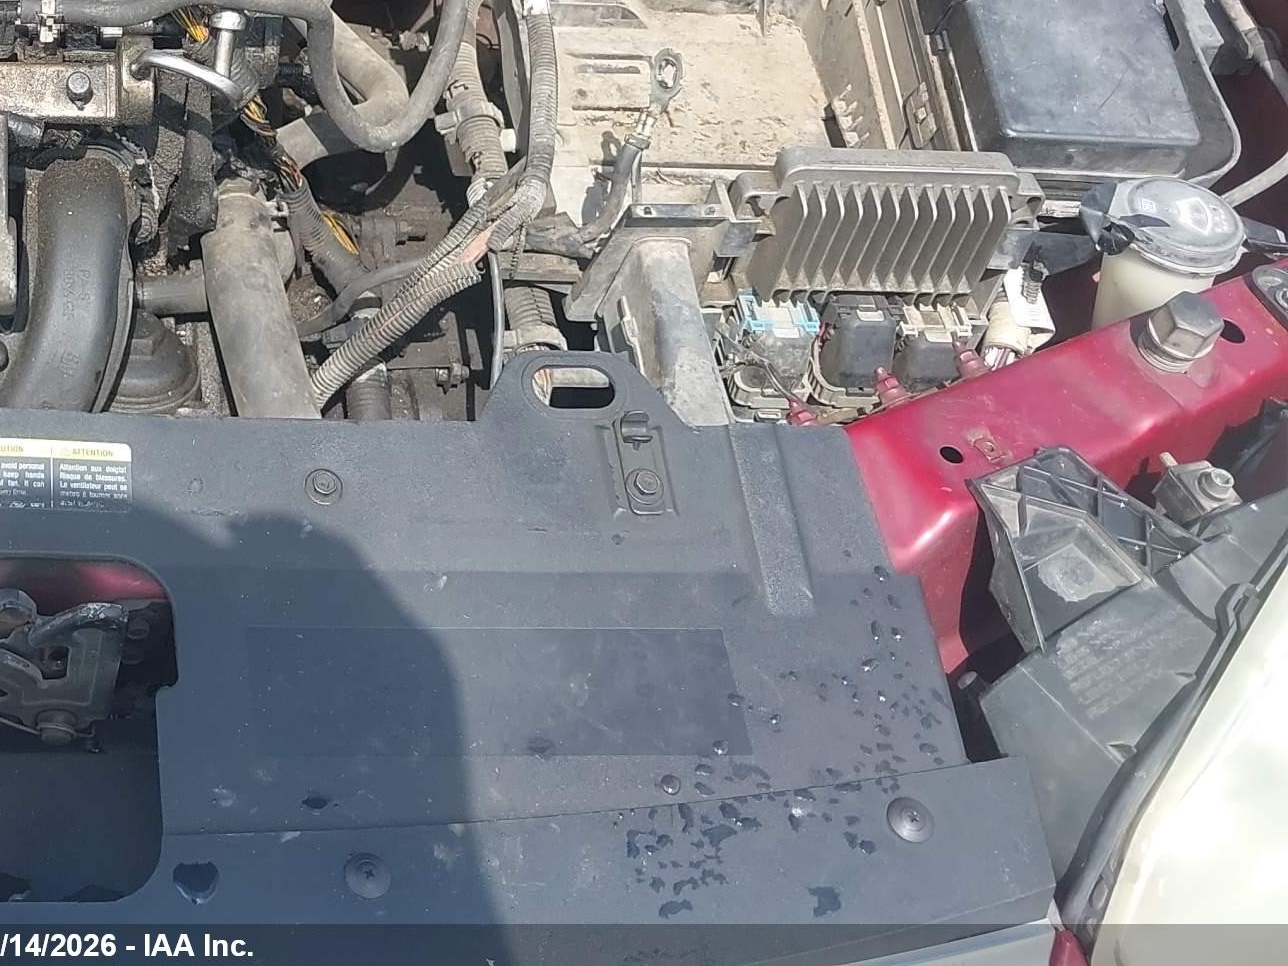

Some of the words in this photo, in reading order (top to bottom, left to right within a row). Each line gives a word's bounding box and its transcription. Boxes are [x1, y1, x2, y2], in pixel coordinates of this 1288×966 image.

[72, 448, 114, 457] ATTENTION
[19, 462, 45, 471] personal
[59, 463, 88, 472] Attention
[3, 471, 19, 479] keep
